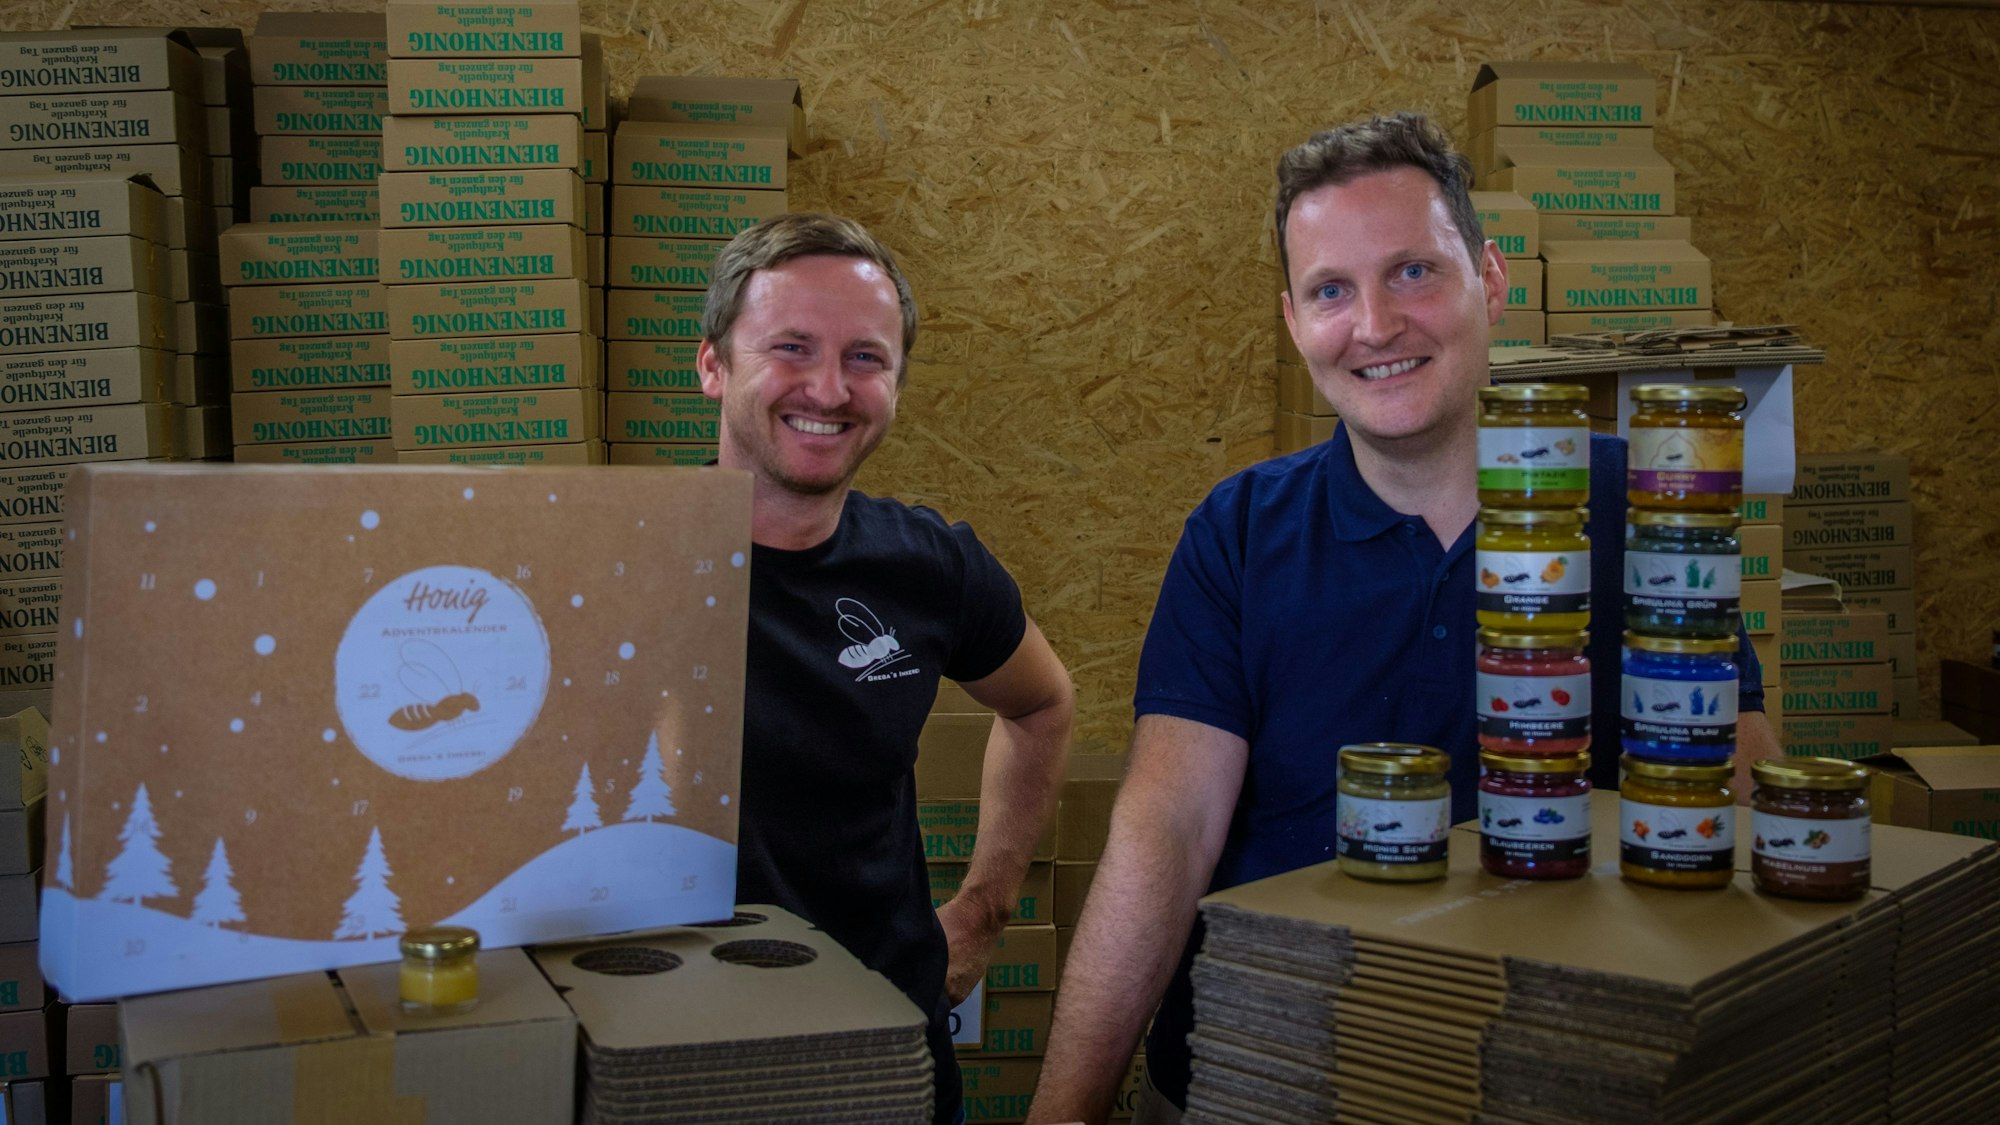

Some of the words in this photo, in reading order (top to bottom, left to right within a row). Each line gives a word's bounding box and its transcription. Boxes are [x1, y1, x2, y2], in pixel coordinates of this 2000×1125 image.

[458, 16, 514, 27] Kraftquelle
[409, 32, 563, 51] BIENENHONIG
[20, 47, 39, 57] Tag
[42, 45, 77, 55] ganzen
[80, 46, 100, 55] den
[103, 45, 117, 54] für
[42, 55, 98, 65] Kraftquelle
[1, 65, 140, 87] BIENENHONIG
[459, 72, 514, 83] Kraftquelle
[410, 88, 564, 108] BIENENHONIG
[30, 101, 48, 111] Tag
[52, 99, 87, 109] ganzen
[90, 100, 109, 109] den
[113, 100, 127, 108] für
[51, 110, 107, 120] Kraftquelle
[1514, 104, 1643, 122] BIENENHONIG
[276, 113, 384, 131] NENHONIG
[10, 119, 149, 141] BIENENHONIG
[454, 129, 510, 139] Kraftquelle
[33, 155, 52, 164] Tag
[55, 153, 90, 162] ganzen
[94, 154, 112, 162] den
[117, 153, 130, 162] für
[405, 145, 559, 165] BIENENHONIG
[55, 163, 111, 172] Kraftquelle
[632, 161, 772, 183] BIENENHONIG
[0, 189, 33, 200] ganze
[38, 190, 56, 199] den
[60, 189, 76, 198] für
[449, 185, 505, 195] Kraftquelle
[1531, 193, 1661, 210] BIENENHONIG
[401, 199, 554, 222] BIENENHONIG
[428, 232, 446, 243] Tag
[448, 231, 484, 241] ganzen
[40, 247, 59, 256] den
[63, 246, 78, 254] für
[448, 241, 504, 252] Kraftquelle
[400, 255, 553, 278] BIENENHONIG
[460, 296, 516, 307] Kraftquelle
[1566, 287, 1697, 306] BIENENHONIG
[4, 302, 42, 312] ganzen
[46, 303, 65, 311] den
[69, 302, 84, 310] für
[298, 297, 352, 309] Kraftquelle
[3, 313, 63, 324] Kraftquelle
[252, 311, 388, 333] IENENHONIG
[412, 308, 565, 334] BIENENHONIG
[71, 358, 86, 366] für
[298, 351, 352, 362] Kraftquelle
[460, 351, 516, 362] Kraftquelle
[6, 359, 44, 369] ganzen
[48, 359, 67, 368] den
[6, 370, 65, 381] Kraftquelle
[412, 364, 565, 388] BIENENHONIG
[443, 398, 461, 409] Tag
[464, 397, 498, 406] ganzen
[300, 404, 353, 415] Kraftquelle
[462, 406, 518, 417] Kraftquelle
[0, 420, 9, 428] Ta
[13, 416, 50, 425] ganzen
[55, 415, 74, 424] den
[78, 414, 93, 423] für
[12, 426, 72, 437] Kraftquelle
[415, 419, 568, 444] BIENENHONIG
[1793, 526, 1894, 545] BIENENHONIG
[516, 565, 531, 579] 16
[614, 561, 625, 576] 3
[694, 560, 713, 574] 23
[140, 573, 156, 589] 11
[363, 568, 374, 583] 7
[403, 579, 491, 623] Honig
[605, 670, 620, 685] 18
[692, 665, 708, 679] 12
[133, 695, 149, 712] 2
[693, 770, 704, 785] 8
[605, 779, 616, 793] 5
[508, 786, 523, 802] 19
[353, 800, 369, 816] 17
[245, 809, 257, 825] 9
[681, 875, 698, 891] 15
[589, 887, 609, 902] 20
